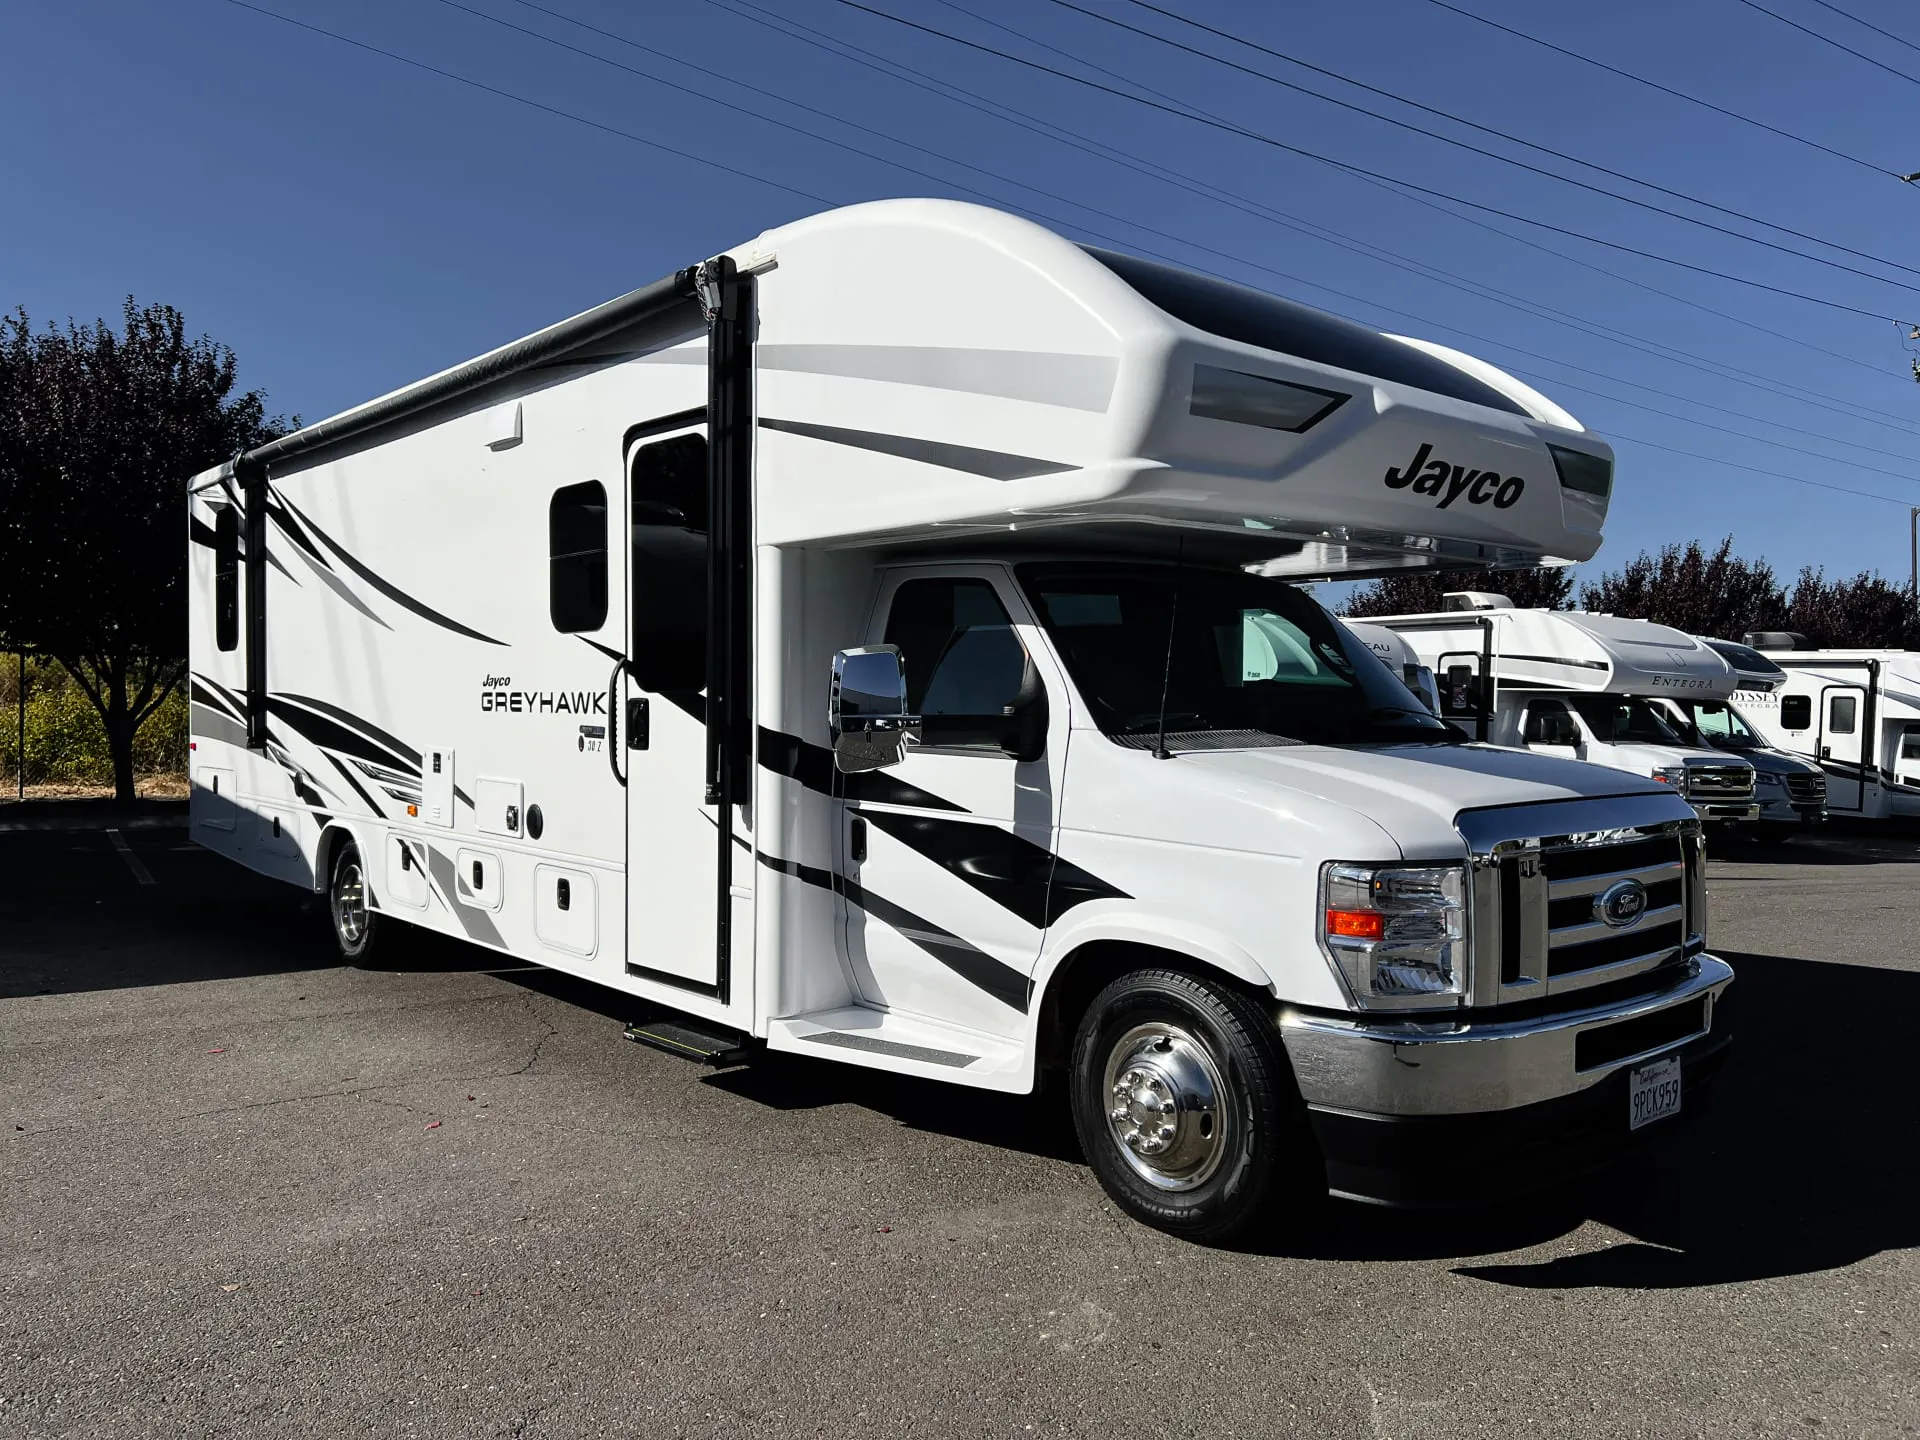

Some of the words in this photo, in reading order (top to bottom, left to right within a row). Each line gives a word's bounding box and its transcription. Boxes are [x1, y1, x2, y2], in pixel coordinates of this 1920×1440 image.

[1384, 443, 1525, 509] Jayco
[483, 674, 511, 689] Jayco
[1652, 676, 1713, 689] ENTEGRA
[482, 692, 608, 714] GREYHAWK
[1618, 894, 1640, 914] Ford
[1633, 1079, 1679, 1121] 9PCK959
